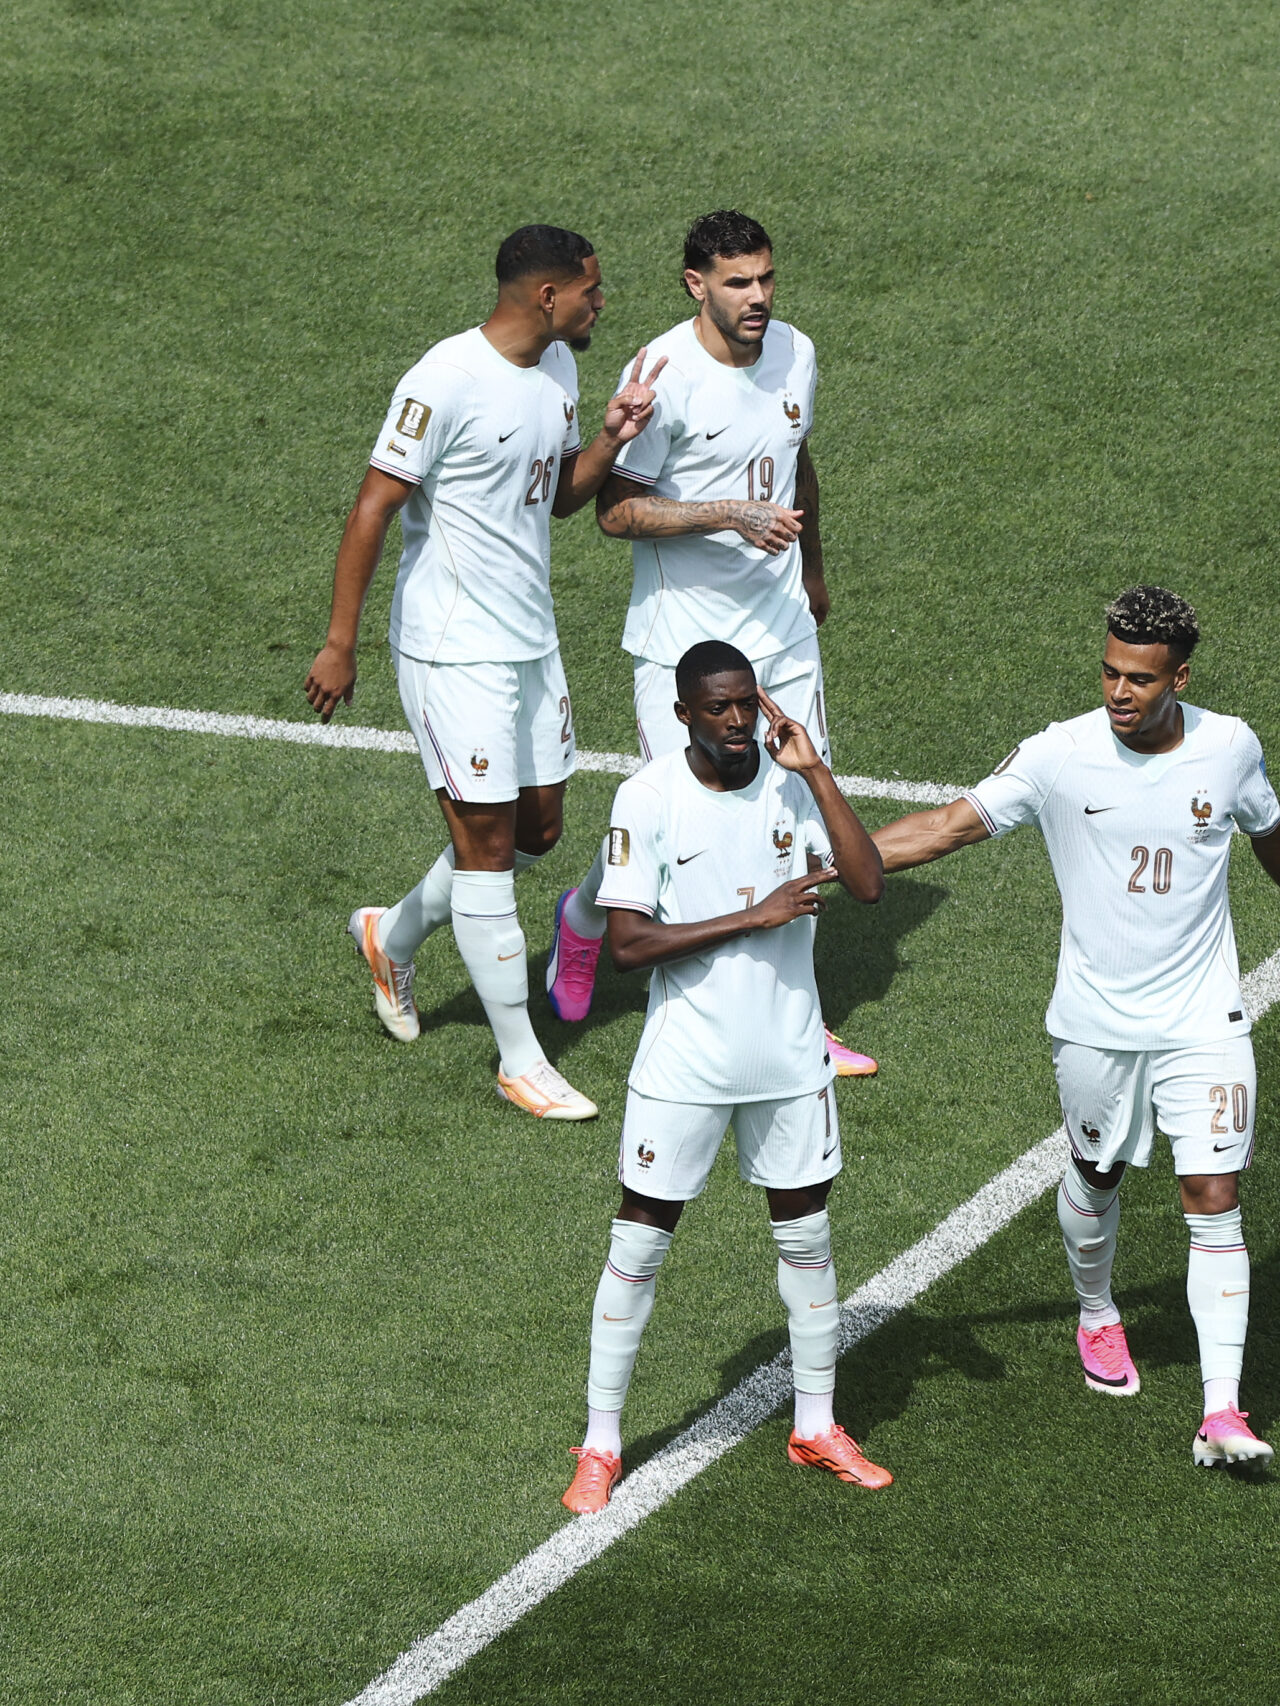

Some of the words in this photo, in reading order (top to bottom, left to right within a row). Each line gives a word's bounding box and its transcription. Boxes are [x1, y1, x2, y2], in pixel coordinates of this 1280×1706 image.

[525, 456, 554, 505] 26
[748, 456, 774, 501] 19
[1128, 846, 1173, 894] 20
[1209, 1084, 1248, 1134] 20
